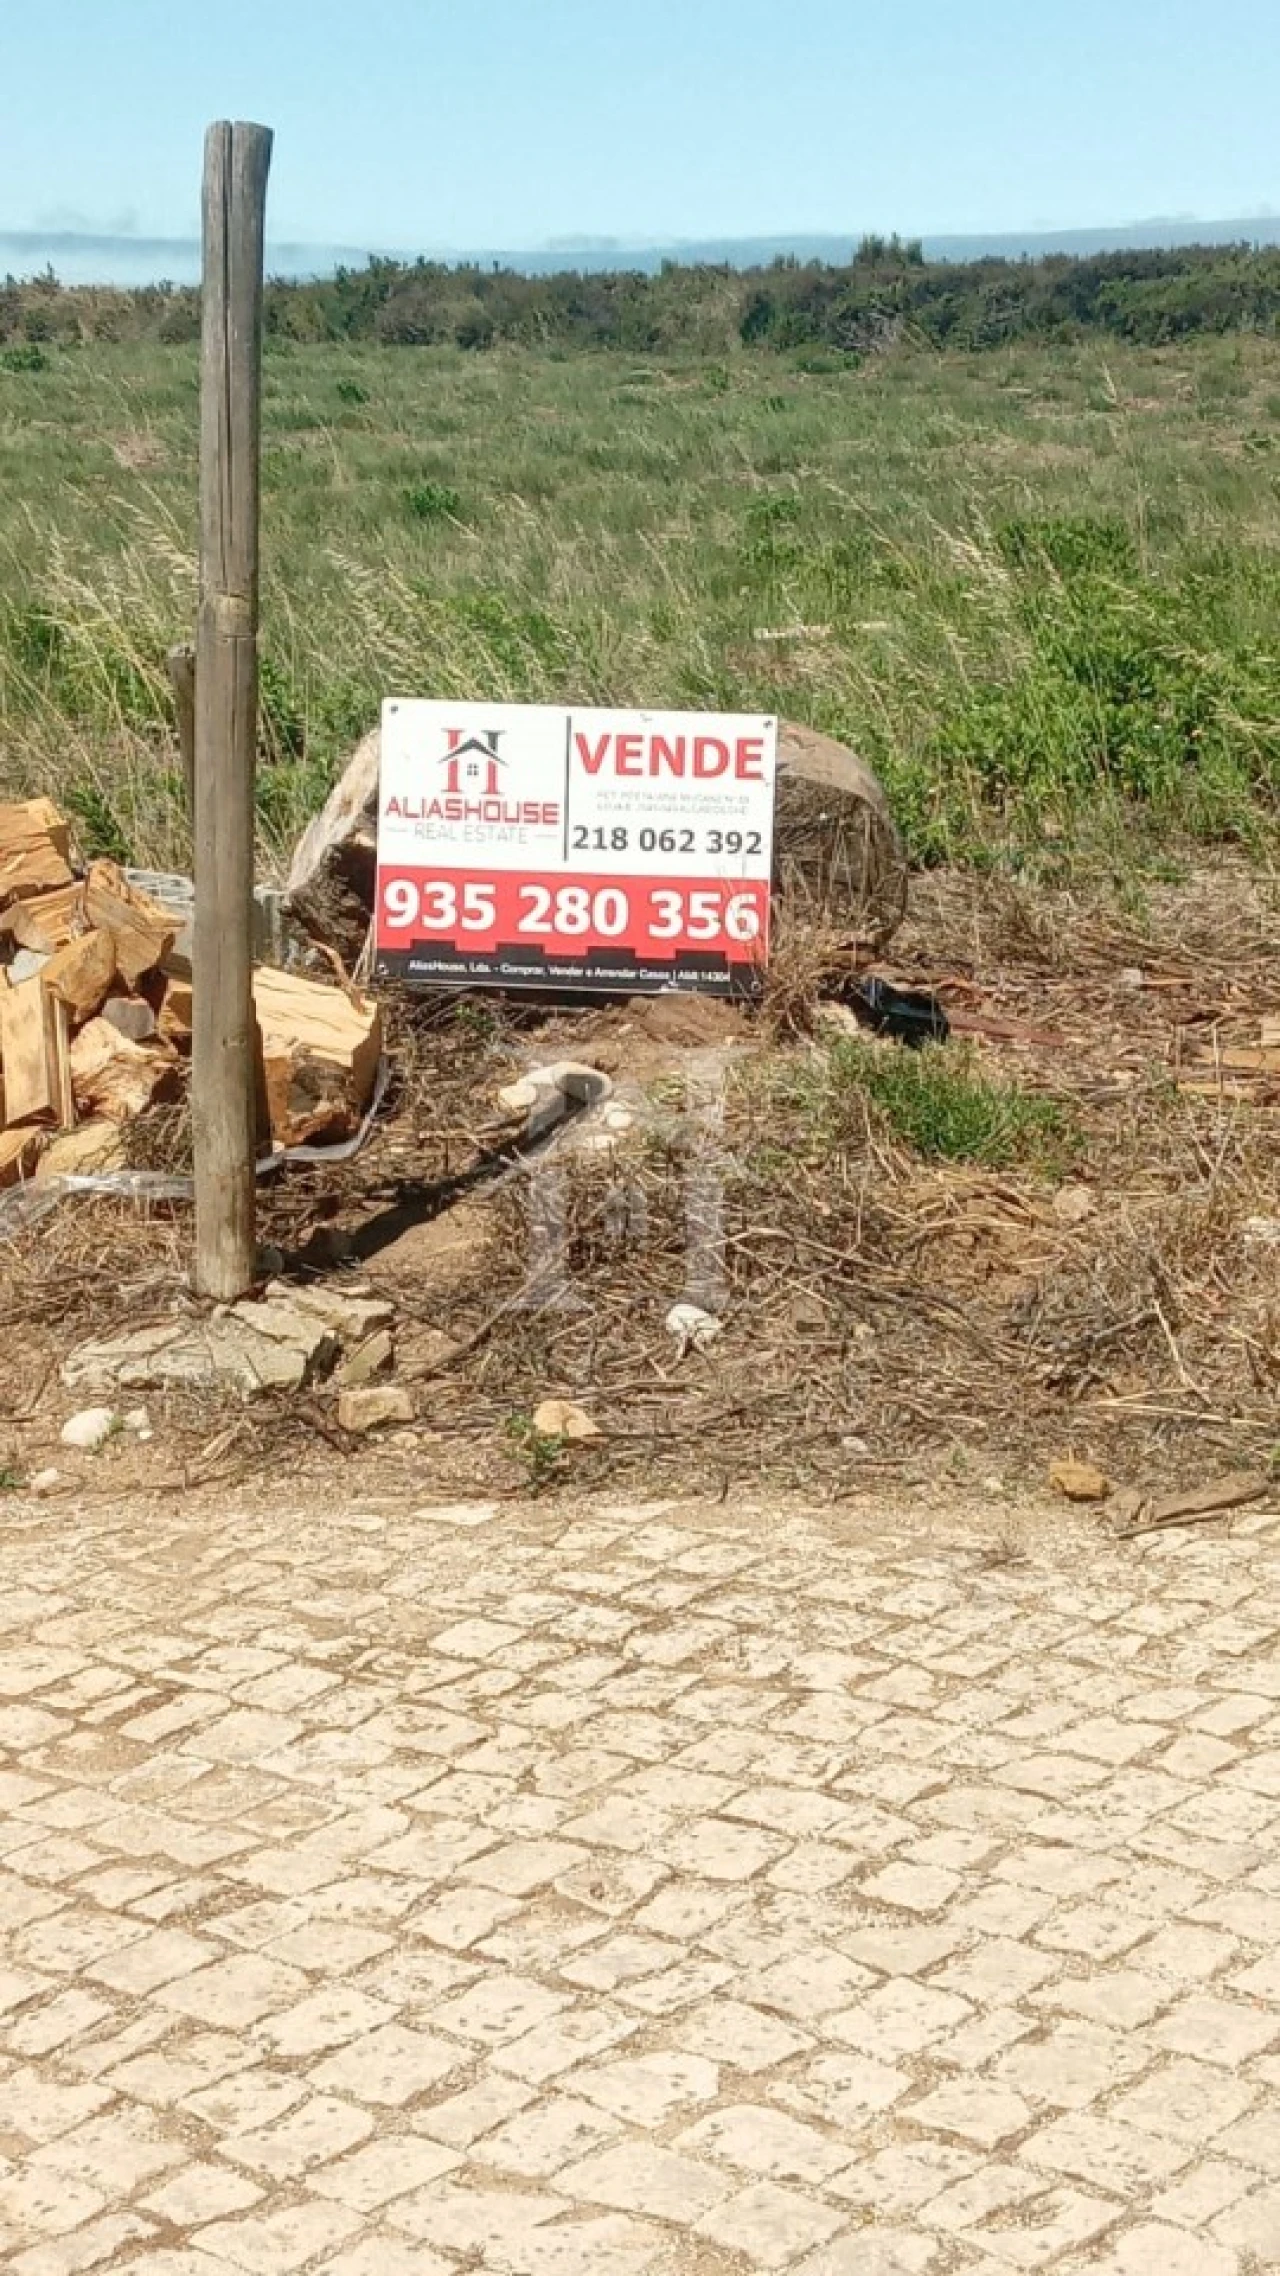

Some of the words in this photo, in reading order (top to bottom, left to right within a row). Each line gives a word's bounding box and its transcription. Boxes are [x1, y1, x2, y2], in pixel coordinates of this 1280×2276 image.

[574, 732, 765, 780] VENDE
[384, 796, 561, 826] ALIASHOUSE
[414, 823, 457, 842] REAL
[463, 825, 529, 845] ESTATE
[572, 825, 629, 852] 218
[639, 827, 695, 853] 062
[705, 829, 762, 854] 392
[383, 879, 497, 930] 935
[516, 884, 630, 936] 280
[648, 890, 760, 942] 356
